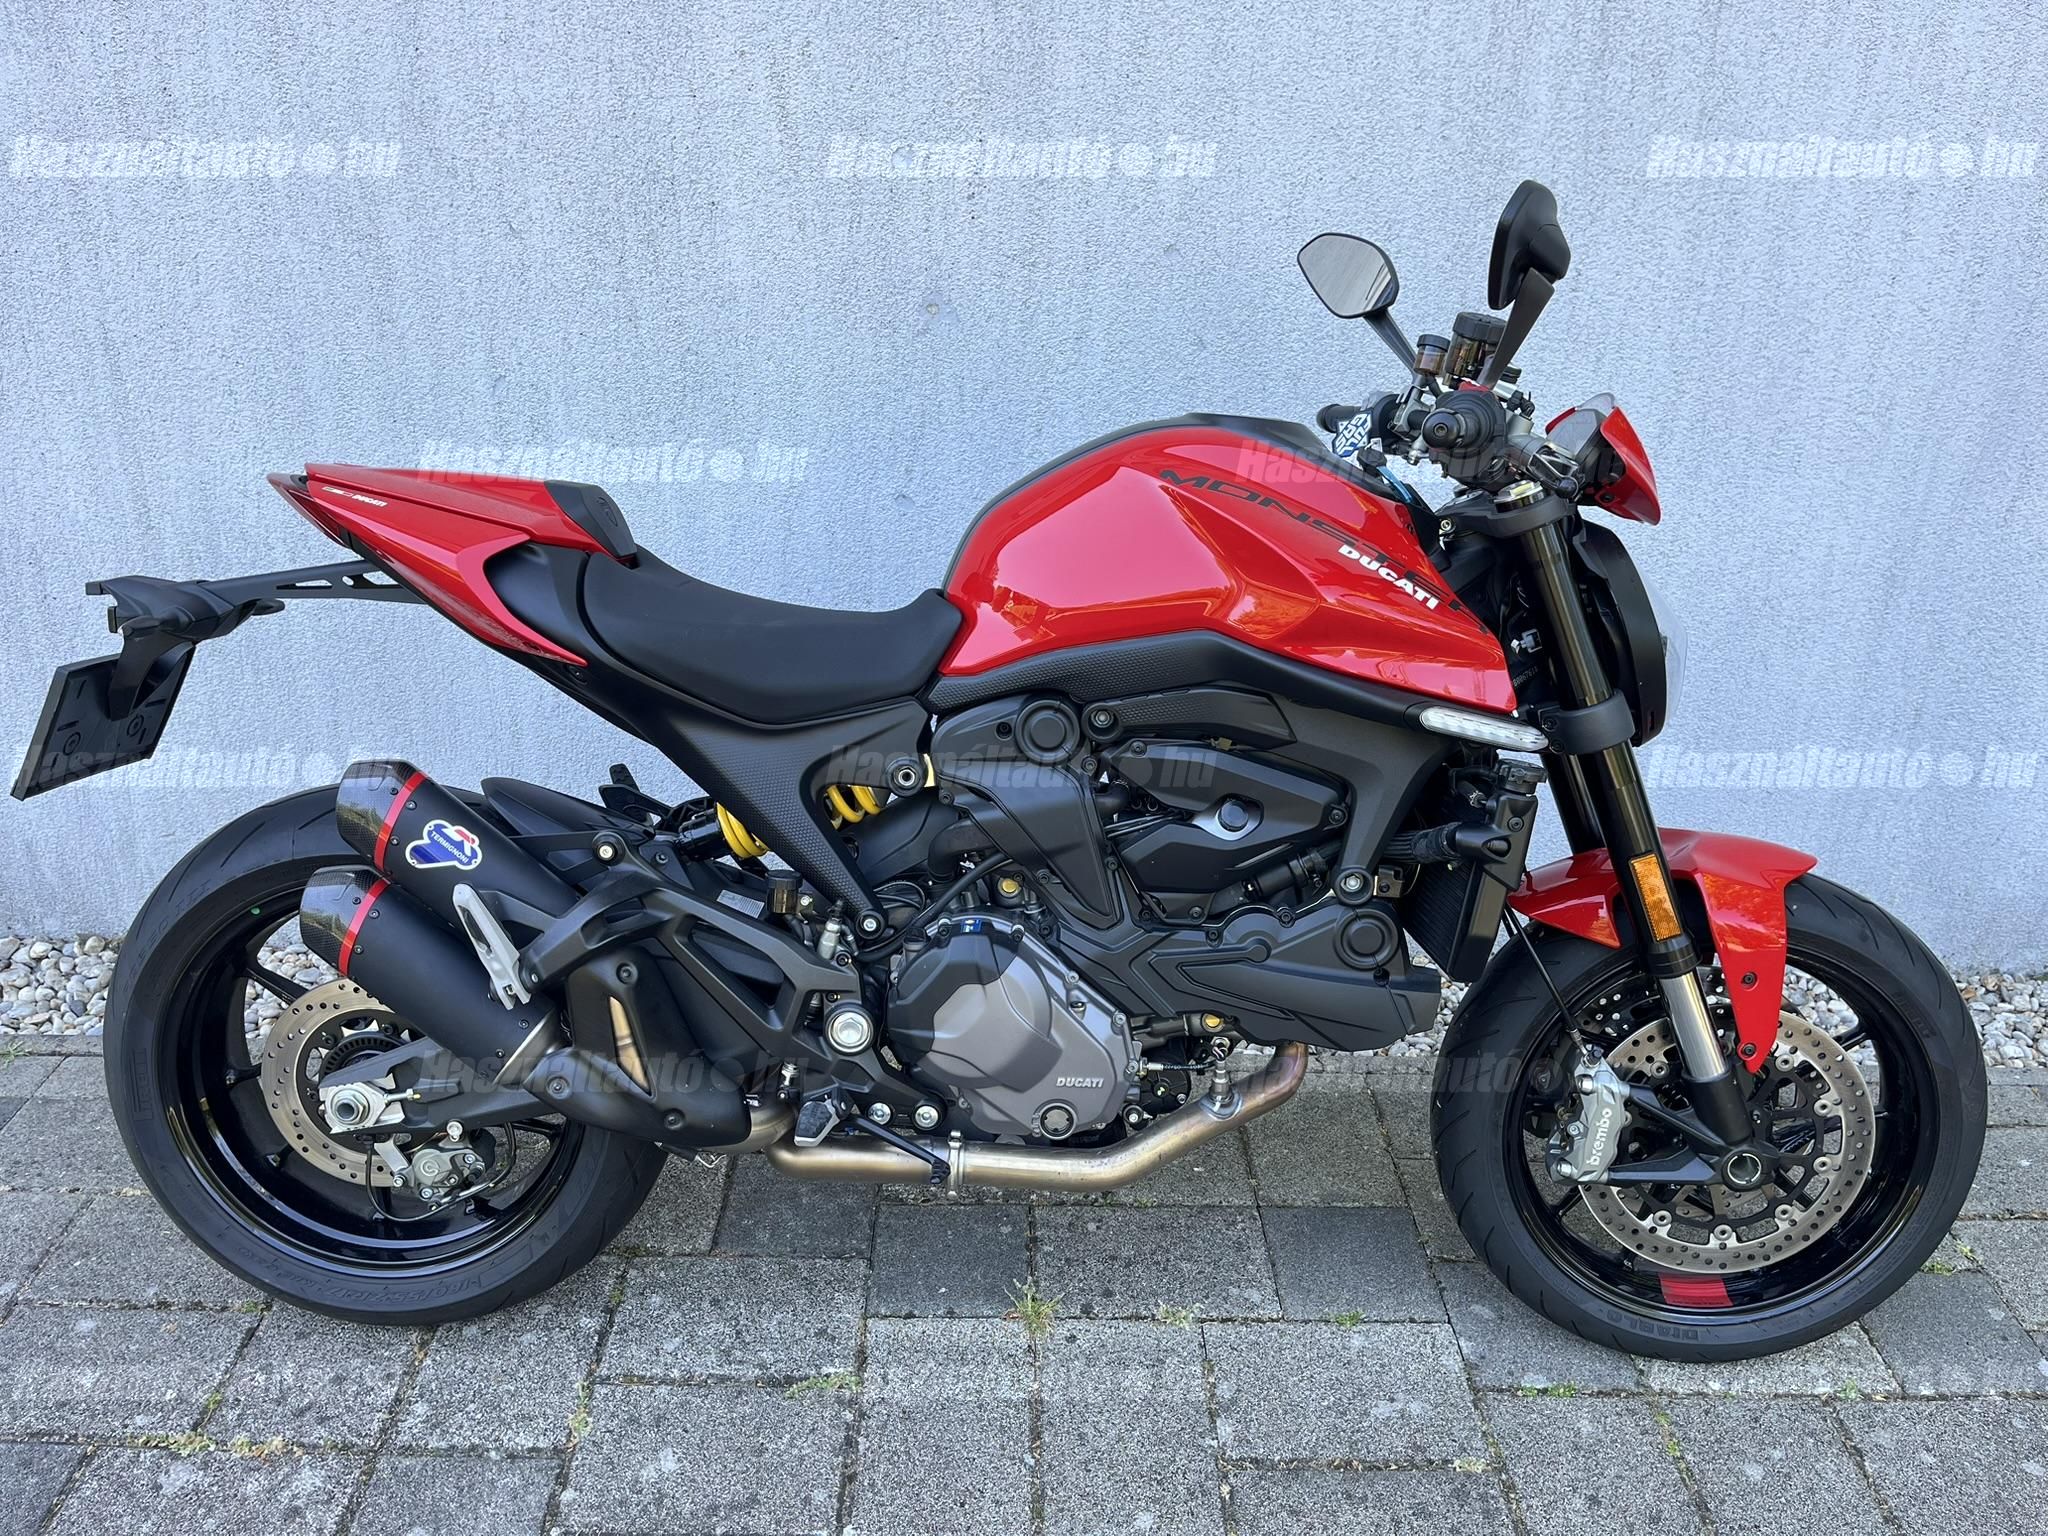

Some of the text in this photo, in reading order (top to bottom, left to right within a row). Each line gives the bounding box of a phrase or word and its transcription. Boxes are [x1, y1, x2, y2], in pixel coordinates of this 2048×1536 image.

[1338, 544, 1439, 609] DUCATI
[431, 831, 470, 863] TERMIGNONI
[1056, 1077, 1104, 1088] DUCATI
[1586, 1108, 1612, 1165] brembo
[1606, 1310, 1699, 1341] DIABLO
